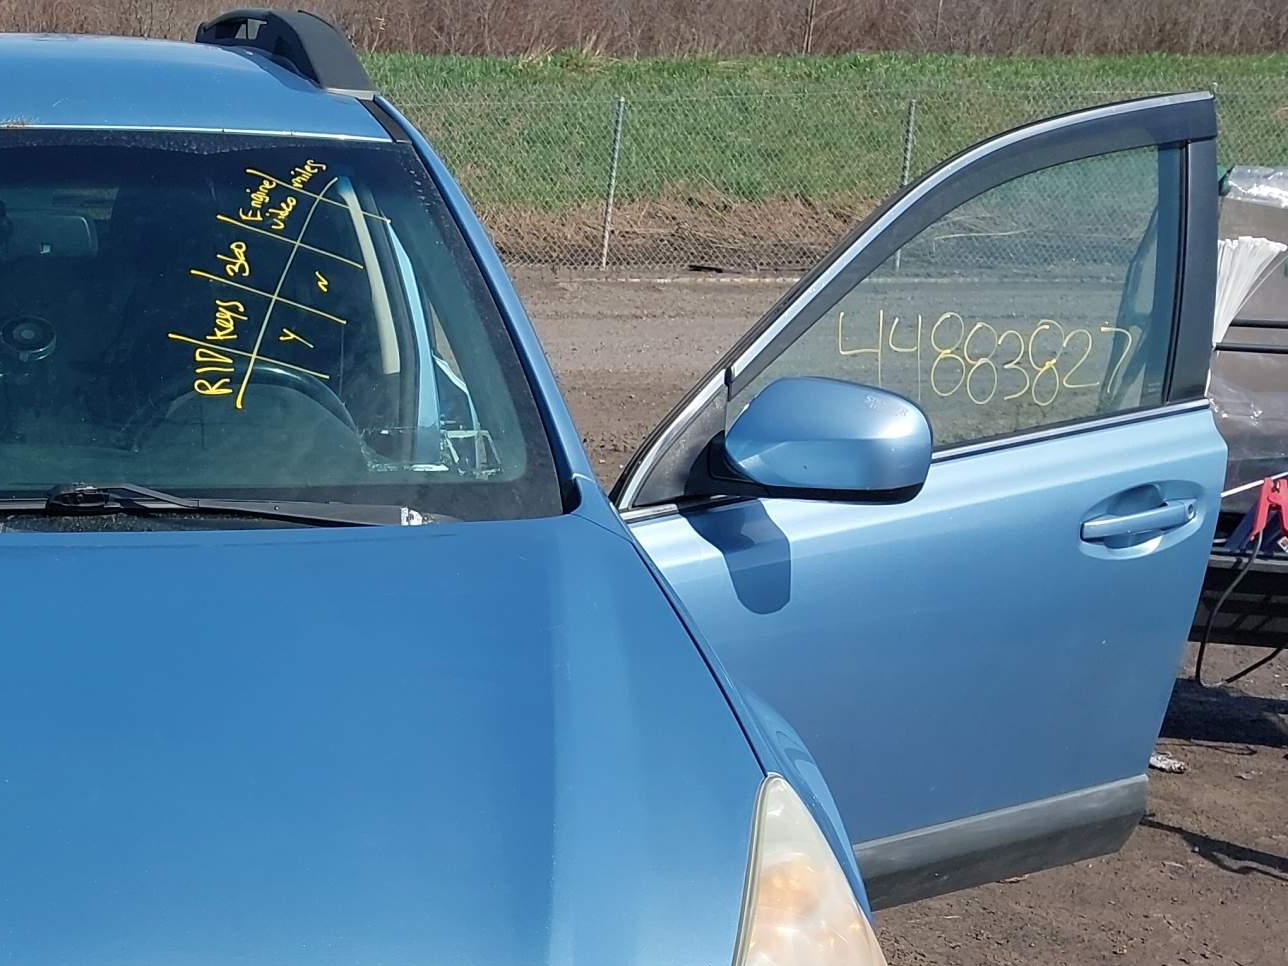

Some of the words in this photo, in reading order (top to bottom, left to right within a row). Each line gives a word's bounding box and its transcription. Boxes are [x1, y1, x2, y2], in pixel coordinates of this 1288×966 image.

[290, 159, 327, 188] miles
[240, 179, 277, 222] Engine
[266, 196, 296, 230] video
[838, 309, 1133, 406] 44883827
